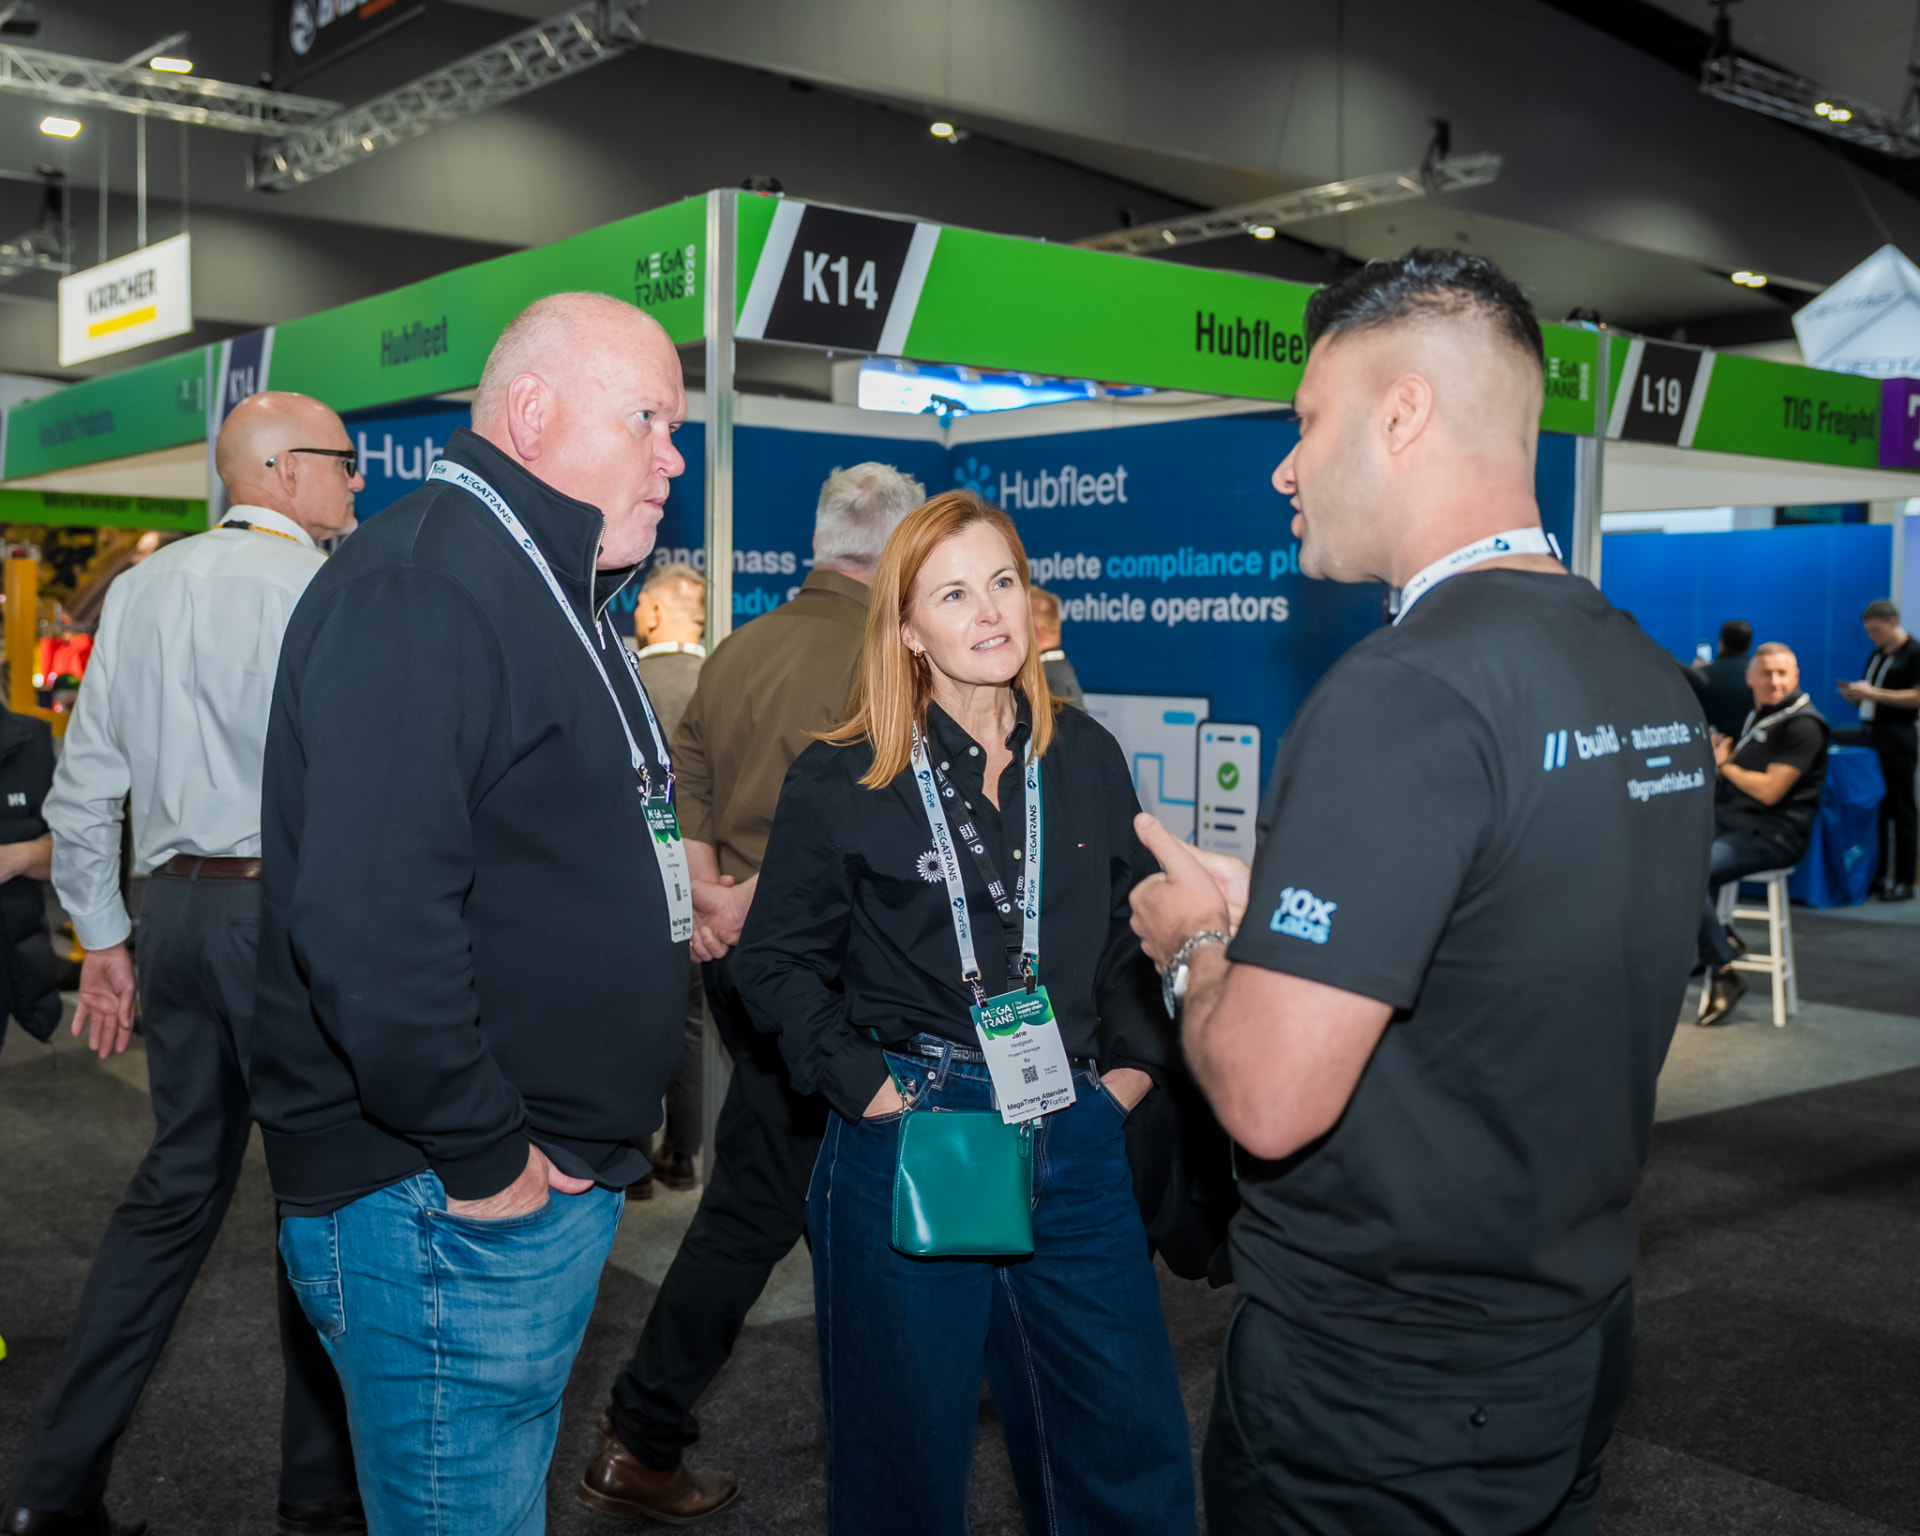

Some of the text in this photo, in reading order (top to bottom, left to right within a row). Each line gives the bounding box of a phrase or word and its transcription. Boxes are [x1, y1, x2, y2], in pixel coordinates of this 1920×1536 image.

[635, 248, 684, 281] MEGA
[803, 250, 879, 310] K14
[635, 275, 684, 307] TRANS
[381, 315, 448, 368] Hubfleet
[1195, 310, 1306, 366] Hubflee
[1641, 374, 1681, 416] L19
[456, 472, 513, 524] MEGATRANS
[1000, 465, 1128, 509] Hubfleet
[1106, 546, 1262, 582] compliance
[1058, 592, 1289, 626] vehicle operators
[1574, 723, 1621, 760] build
[1630, 720, 1692, 750] automate
[923, 782, 936, 808] FarEye
[1029, 804, 1037, 863] MEGATRANS
[934, 822, 957, 882] MEGATRANS
[1028, 879, 1036, 906] FarEye
[1279, 885, 1338, 927] 10x
[957, 911, 967, 939] FarEye
[981, 1003, 1012, 1020] MEGA
[983, 1013, 1015, 1029] TRANS
[1011, 1039, 1033, 1049] Hodgson
[1012, 1031, 1027, 1039] Jane
[1023, 1046, 1041, 1054] Manager
[1007, 1087, 1068, 1111] MegaTrans Attendee
[1049, 1095, 1070, 1107] FarEye
